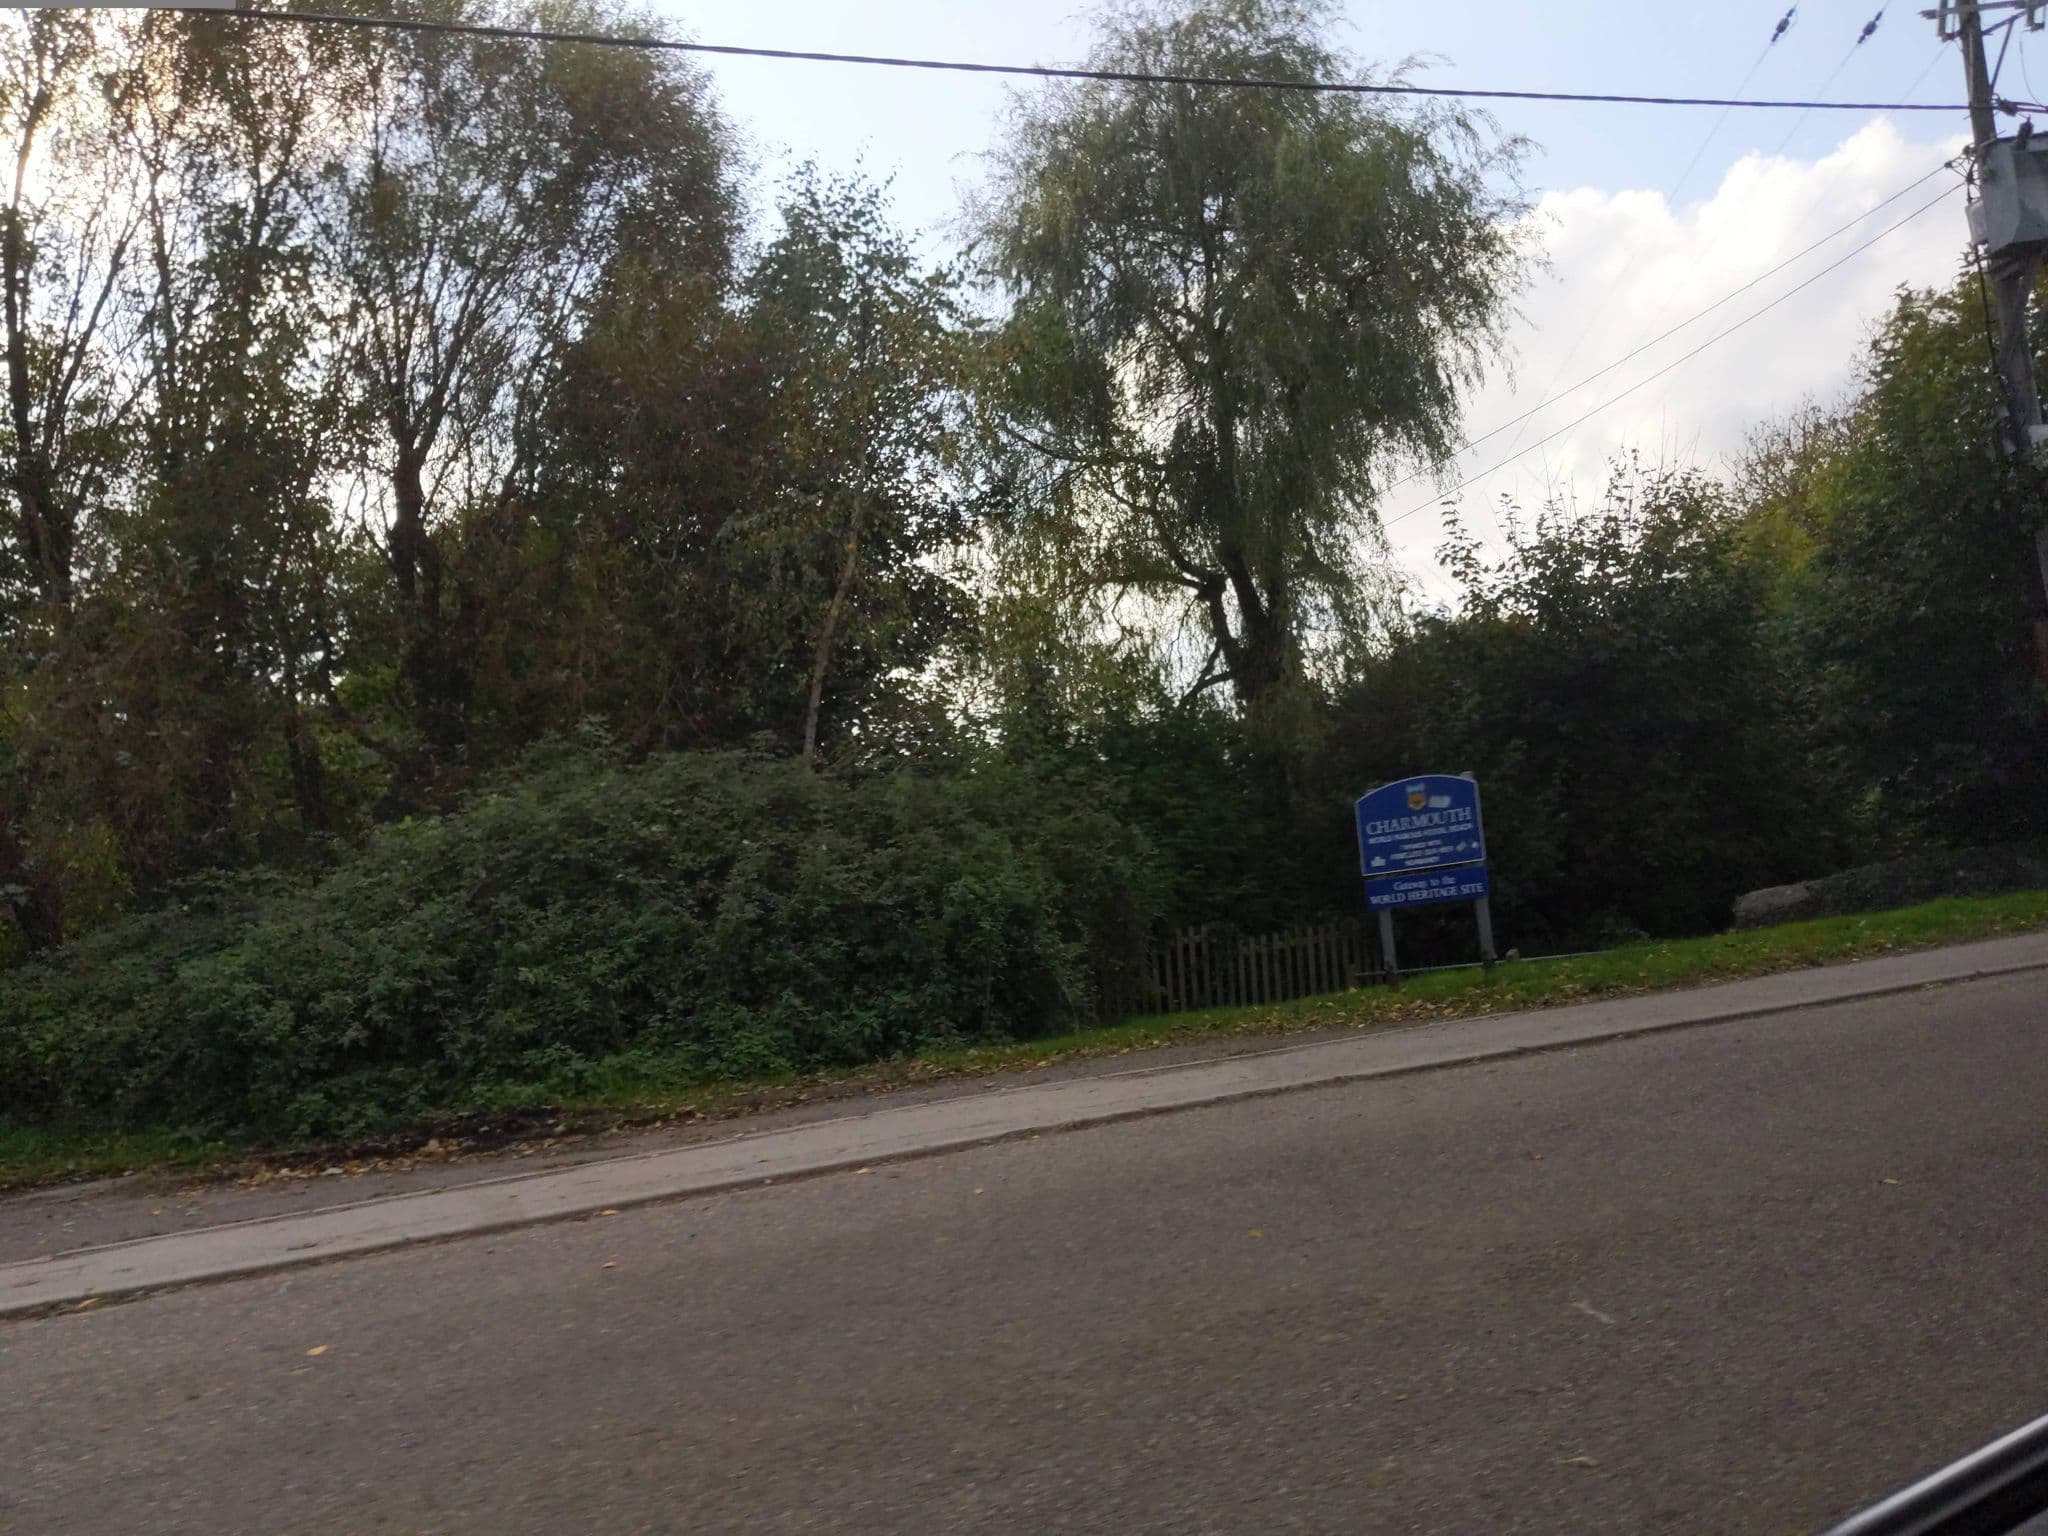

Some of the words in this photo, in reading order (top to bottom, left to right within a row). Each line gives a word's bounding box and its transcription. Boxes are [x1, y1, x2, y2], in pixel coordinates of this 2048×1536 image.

[1366, 807, 1472, 835] CHARMOUTH
[1370, 893, 1407, 904] WORLD
[1407, 886, 1458, 901] HERITAGE
[1460, 883, 1485, 894] SITE
